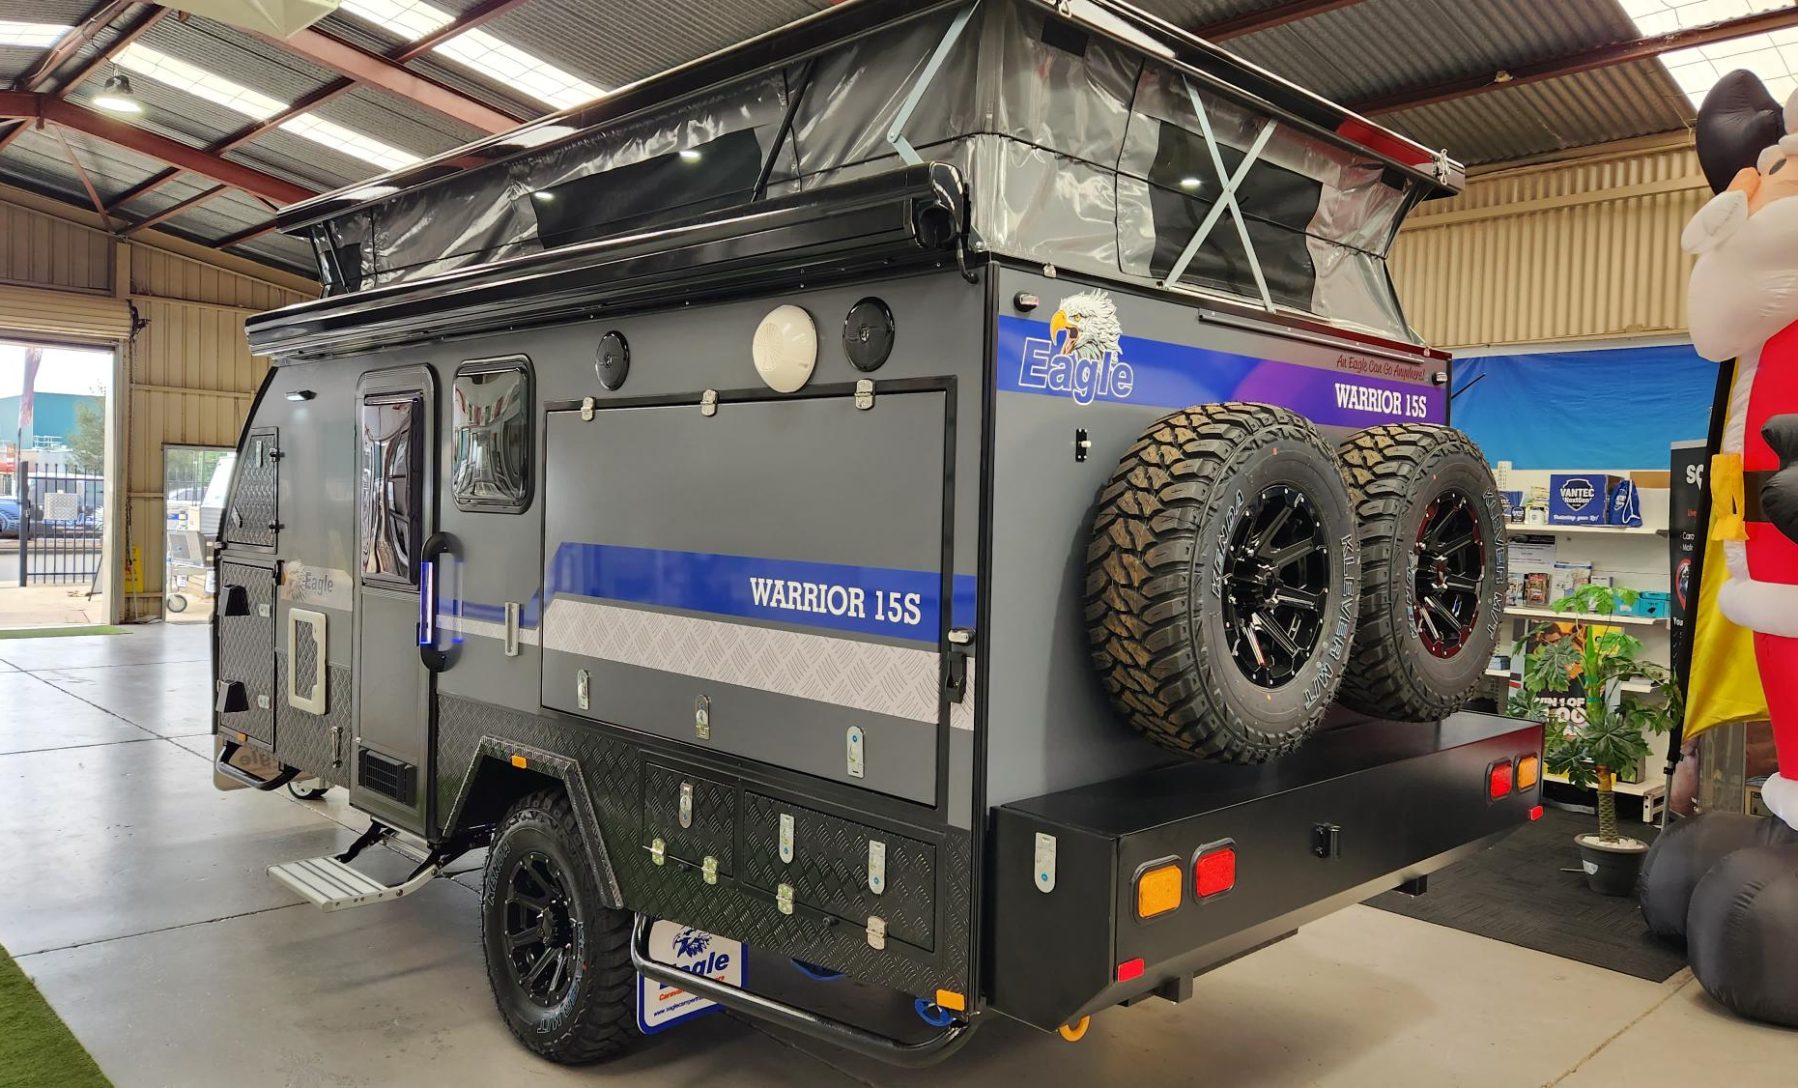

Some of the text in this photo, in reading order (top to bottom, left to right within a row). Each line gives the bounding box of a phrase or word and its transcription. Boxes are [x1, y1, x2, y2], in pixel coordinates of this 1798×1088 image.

[1018, 337, 1134, 406] Eagle
[1349, 357, 1368, 373] Eagle
[1368, 360, 1382, 374] Can
[1384, 362, 1393, 375] Go
[1334, 382, 1427, 418] WARRIOR 15S
[1560, 488, 1595, 498] VANTEC
[303, 571, 334, 596] Eagle
[750, 577, 922, 626] WARRIOR 15S
[1330, 534, 1354, 661] KLEVER
